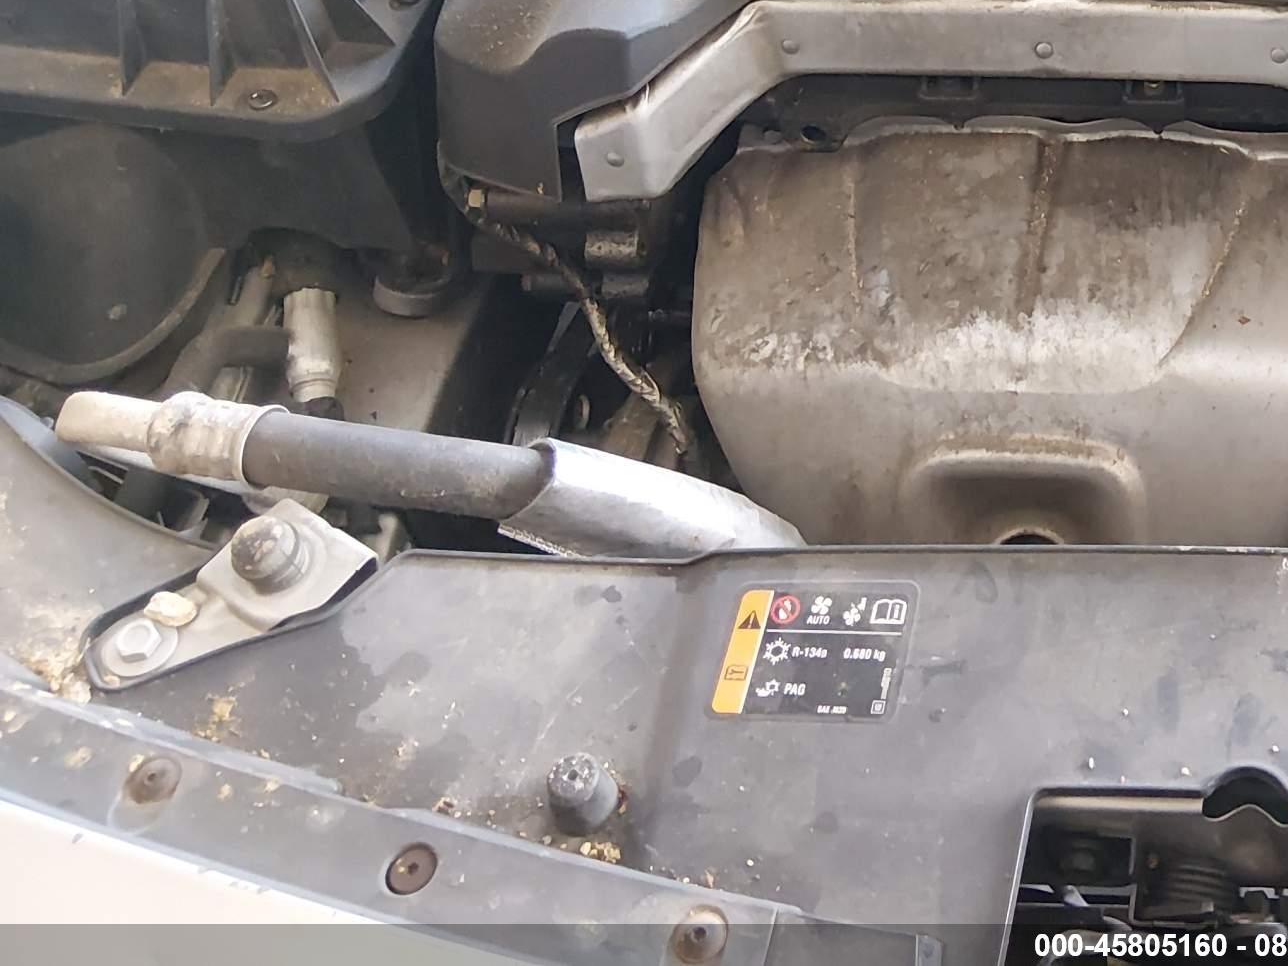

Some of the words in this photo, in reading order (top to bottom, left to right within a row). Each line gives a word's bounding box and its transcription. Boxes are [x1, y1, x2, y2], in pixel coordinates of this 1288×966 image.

[806, 614, 831, 625] AUTO
[873, 649, 886, 662] kg
[783, 682, 806, 695] PAG
